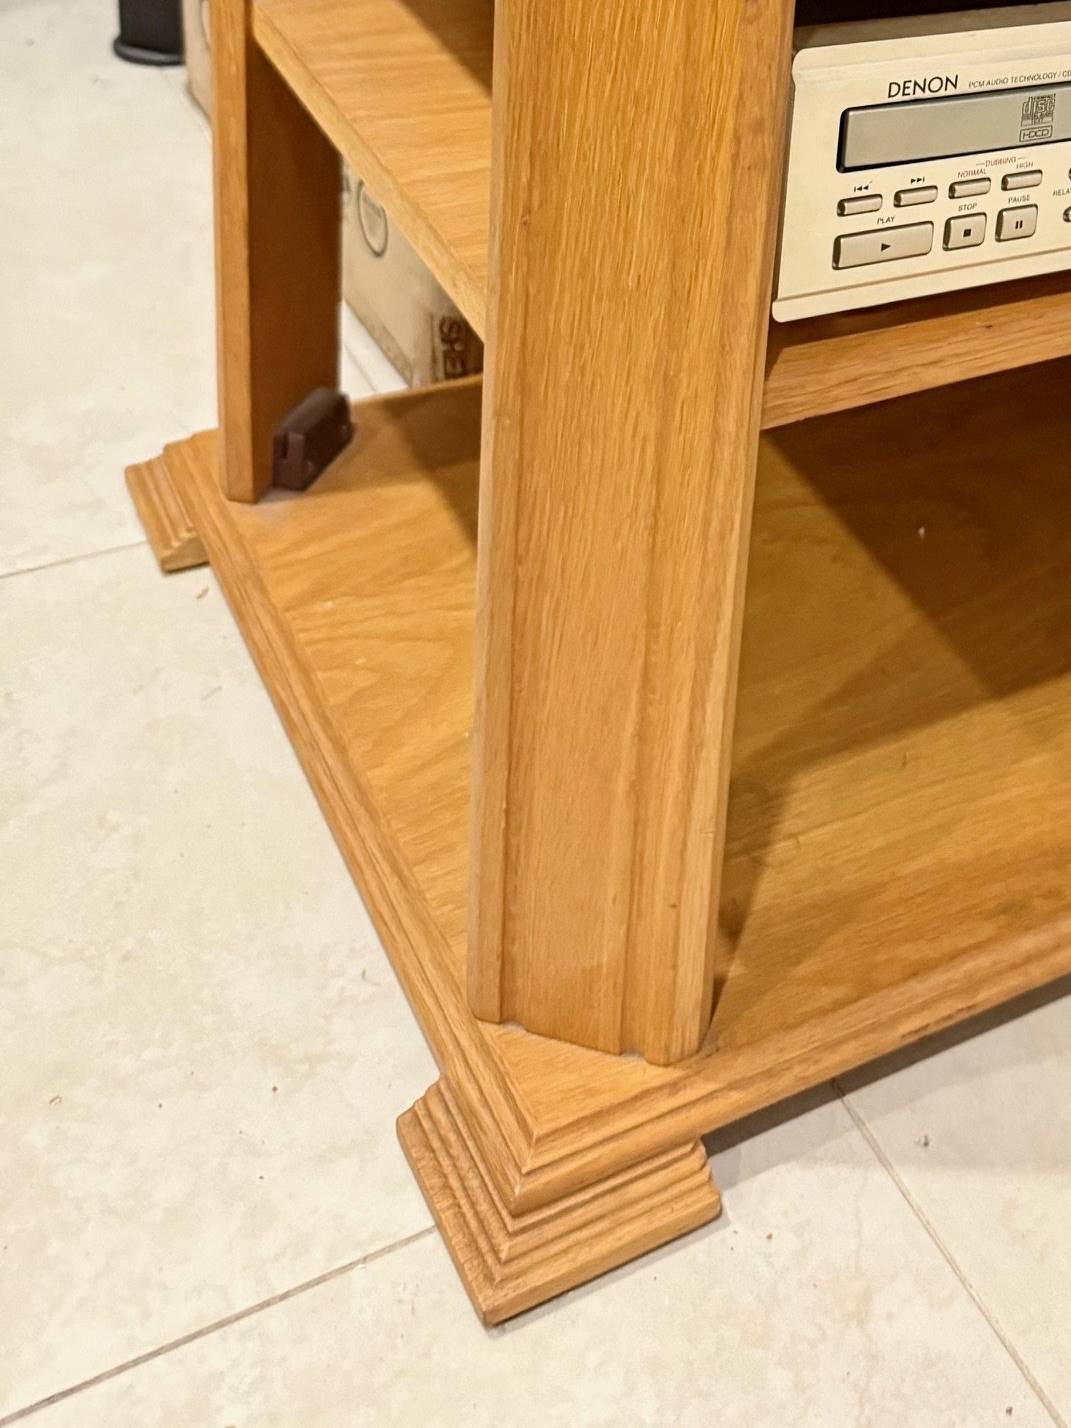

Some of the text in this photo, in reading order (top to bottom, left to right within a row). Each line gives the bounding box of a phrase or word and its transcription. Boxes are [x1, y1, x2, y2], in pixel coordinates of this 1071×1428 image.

[968, 80, 985, 89] PCM
[986, 77, 1008, 86] AUDIO
[1010, 72, 1057, 85] TECHNOLOGY
[887, 74, 959, 98] DENON
[957, 168, 987, 178] NORMAL
[1008, 194, 1031, 204] PAUSE
[958, 202, 978, 212] STOP
[876, 215, 896, 225] PLAY
